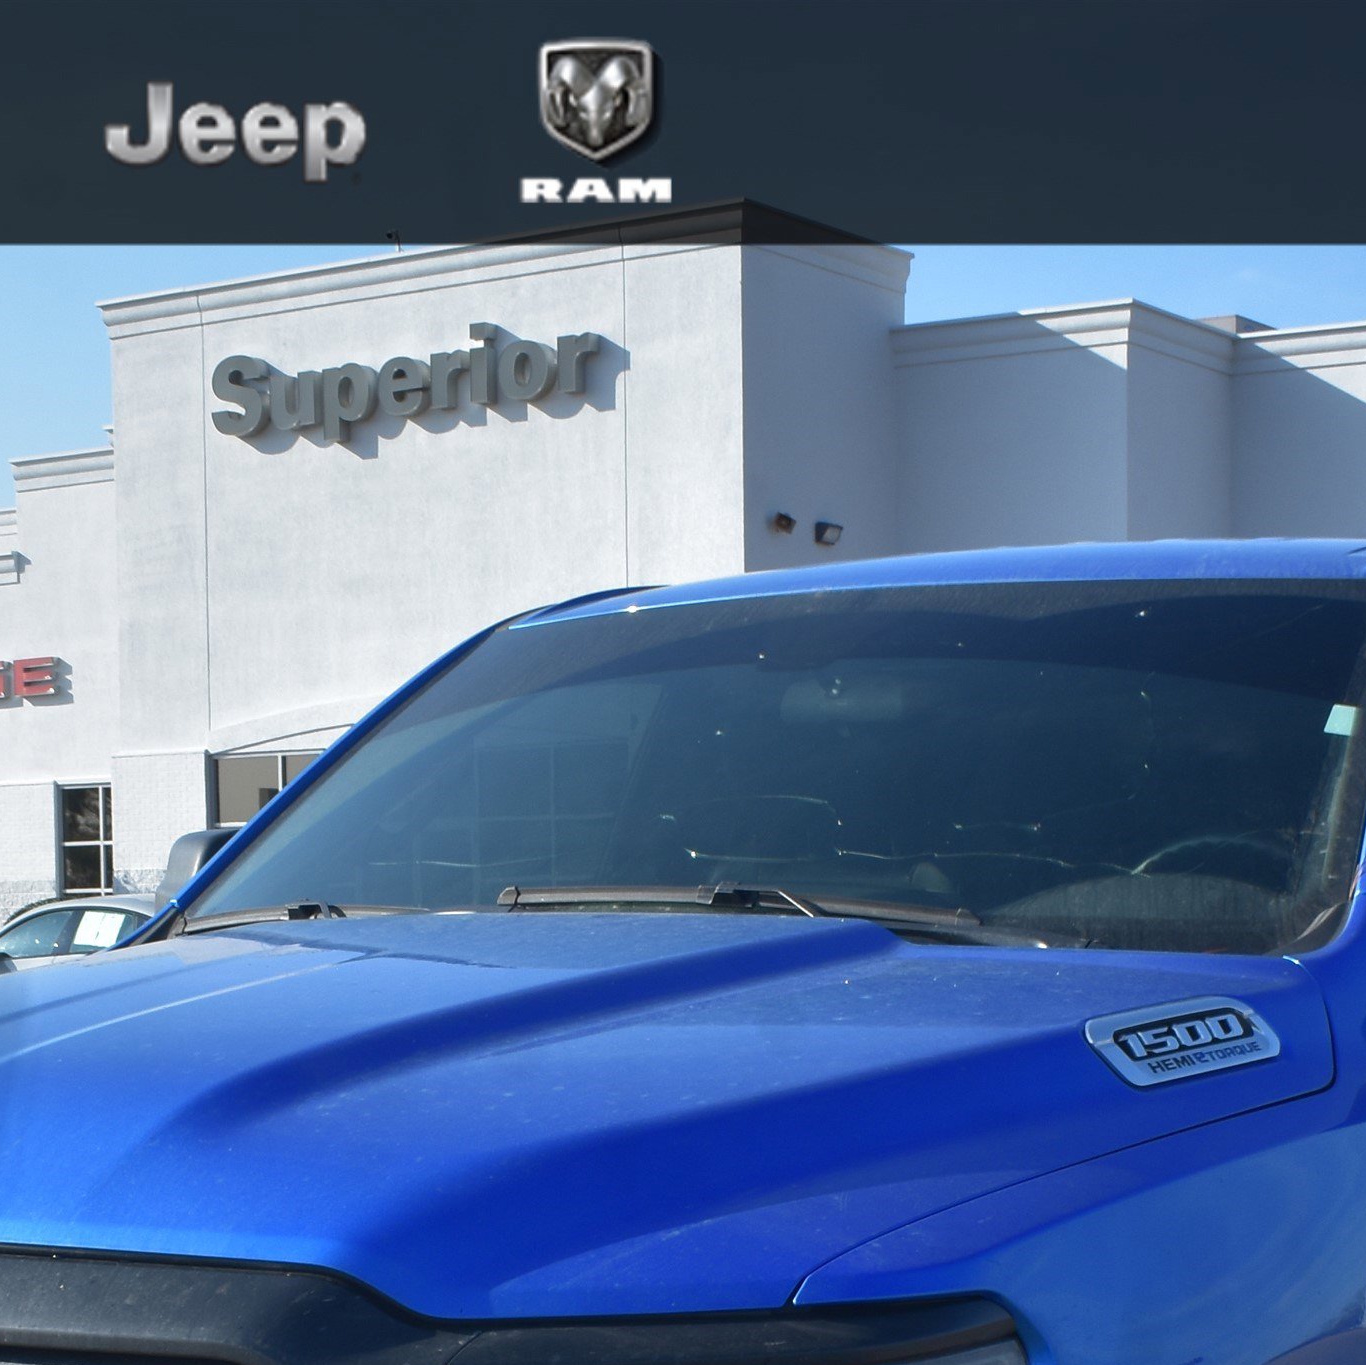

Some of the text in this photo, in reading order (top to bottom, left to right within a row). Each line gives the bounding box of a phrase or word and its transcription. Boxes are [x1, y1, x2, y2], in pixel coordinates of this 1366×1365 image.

[211, 322, 601, 443] Superior
[1119, 1014, 1244, 1058] 1500
[1148, 1054, 1196, 1074] HEMI
